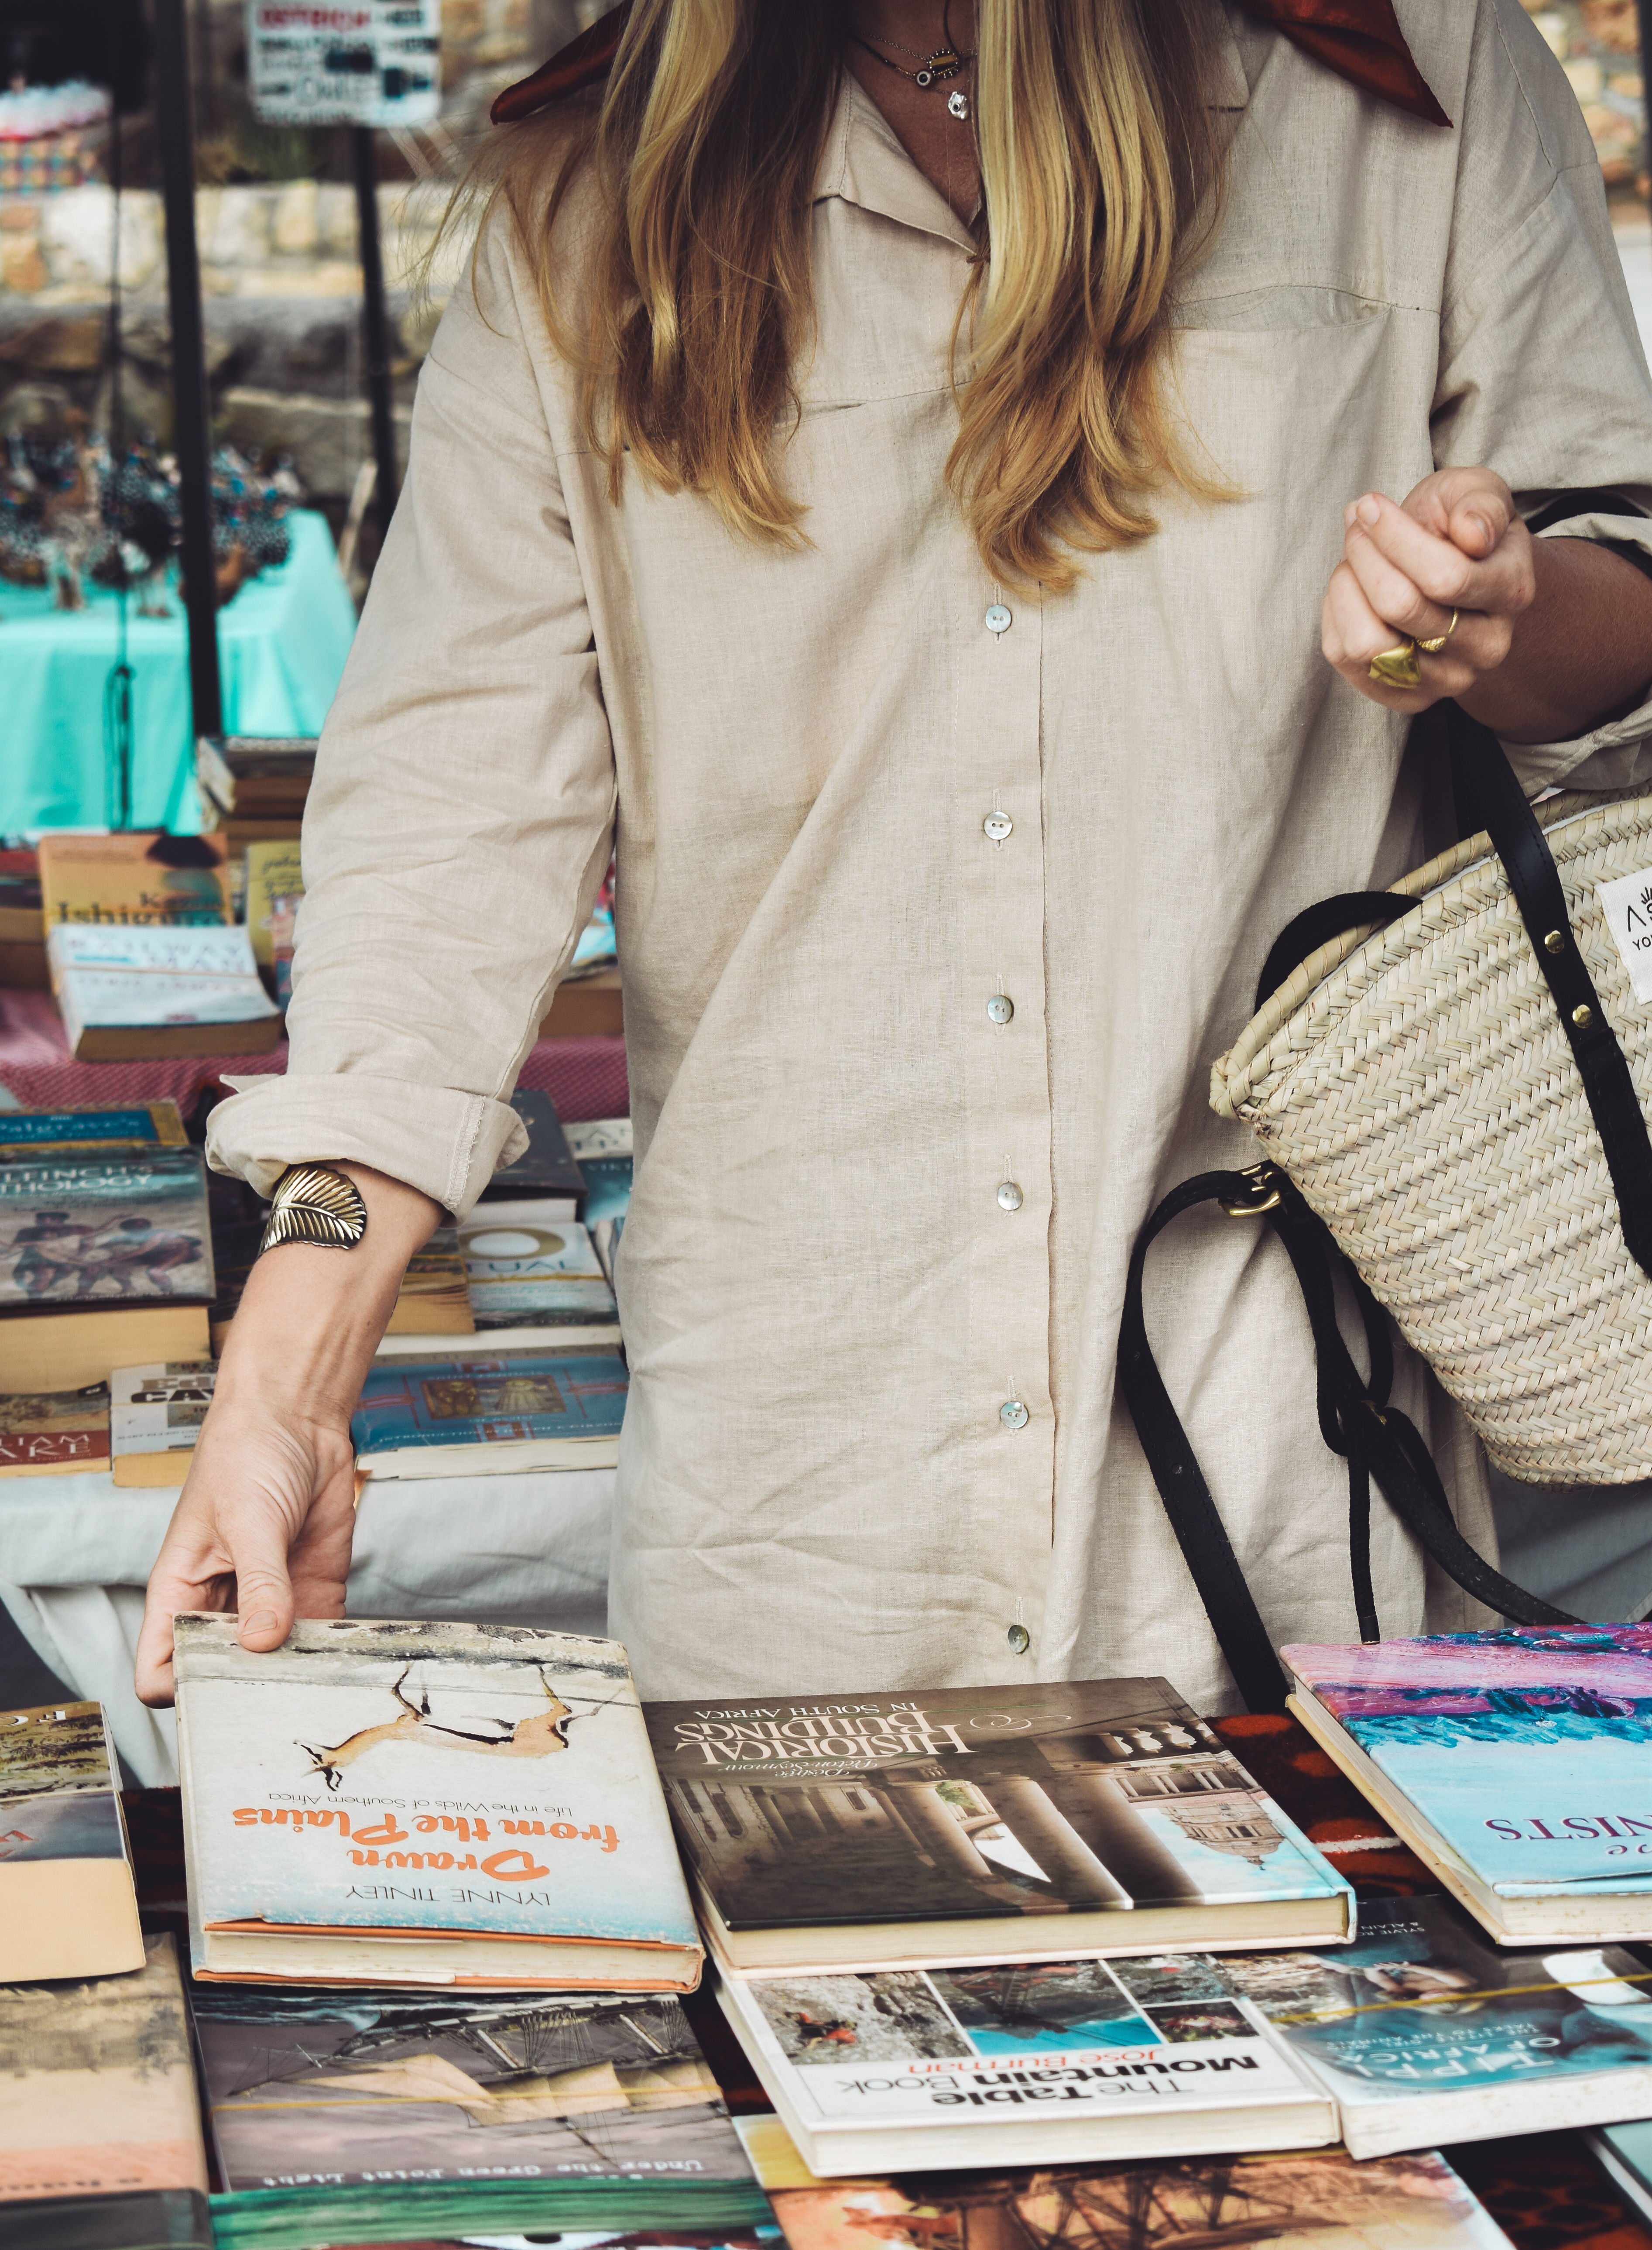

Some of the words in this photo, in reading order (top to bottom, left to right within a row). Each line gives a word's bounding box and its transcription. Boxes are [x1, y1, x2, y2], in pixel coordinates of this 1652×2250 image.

[1632, 934, 1652, 950] YO
[693, 1708, 782, 1719] AFRICA
[789, 1704, 880, 1716] SOUTH
[890, 1702, 918, 1711] IN
[674, 1711, 941, 1742] BUILDINGS
[675, 1724, 979, 1764] HISTORICAL
[269, 1793, 321, 1805] Africa
[328, 1796, 405, 1808] Southern
[412, 1799, 430, 1810] of
[435, 1800, 489, 1812] Wilds
[492, 1803, 518, 1814] the
[525, 1805, 538, 1813] in
[544, 1806, 572, 1817] Life
[233, 1808, 409, 1845] Plains
[411, 1815, 491, 1842] the
[498, 1819, 620, 1853] from
[346, 1849, 550, 1881] Drawn
[346, 1885, 440, 1902] TINLEY
[450, 1889, 550, 1906] LYNNE
[1507, 2037, 1561, 2050] OF
[1080, 2049, 1164, 2063] Jose
[1337, 2043, 1489, 2063] AFRICA
[909, 2056, 1066, 2074] Burman
[973, 2056, 1259, 2087] Mountain
[1354, 2052, 1554, 2079] TIPPI
[836, 2075, 960, 2094] Book
[1097, 2079, 1195, 2095] The
[932, 2086, 1093, 2106] Table
[457, 2164, 541, 2176] Green
[557, 2163, 603, 2173] the
[621, 2159, 704, 2171] Under
[263, 2172, 345, 2186] Light
[361, 2168, 443, 2181] Point
